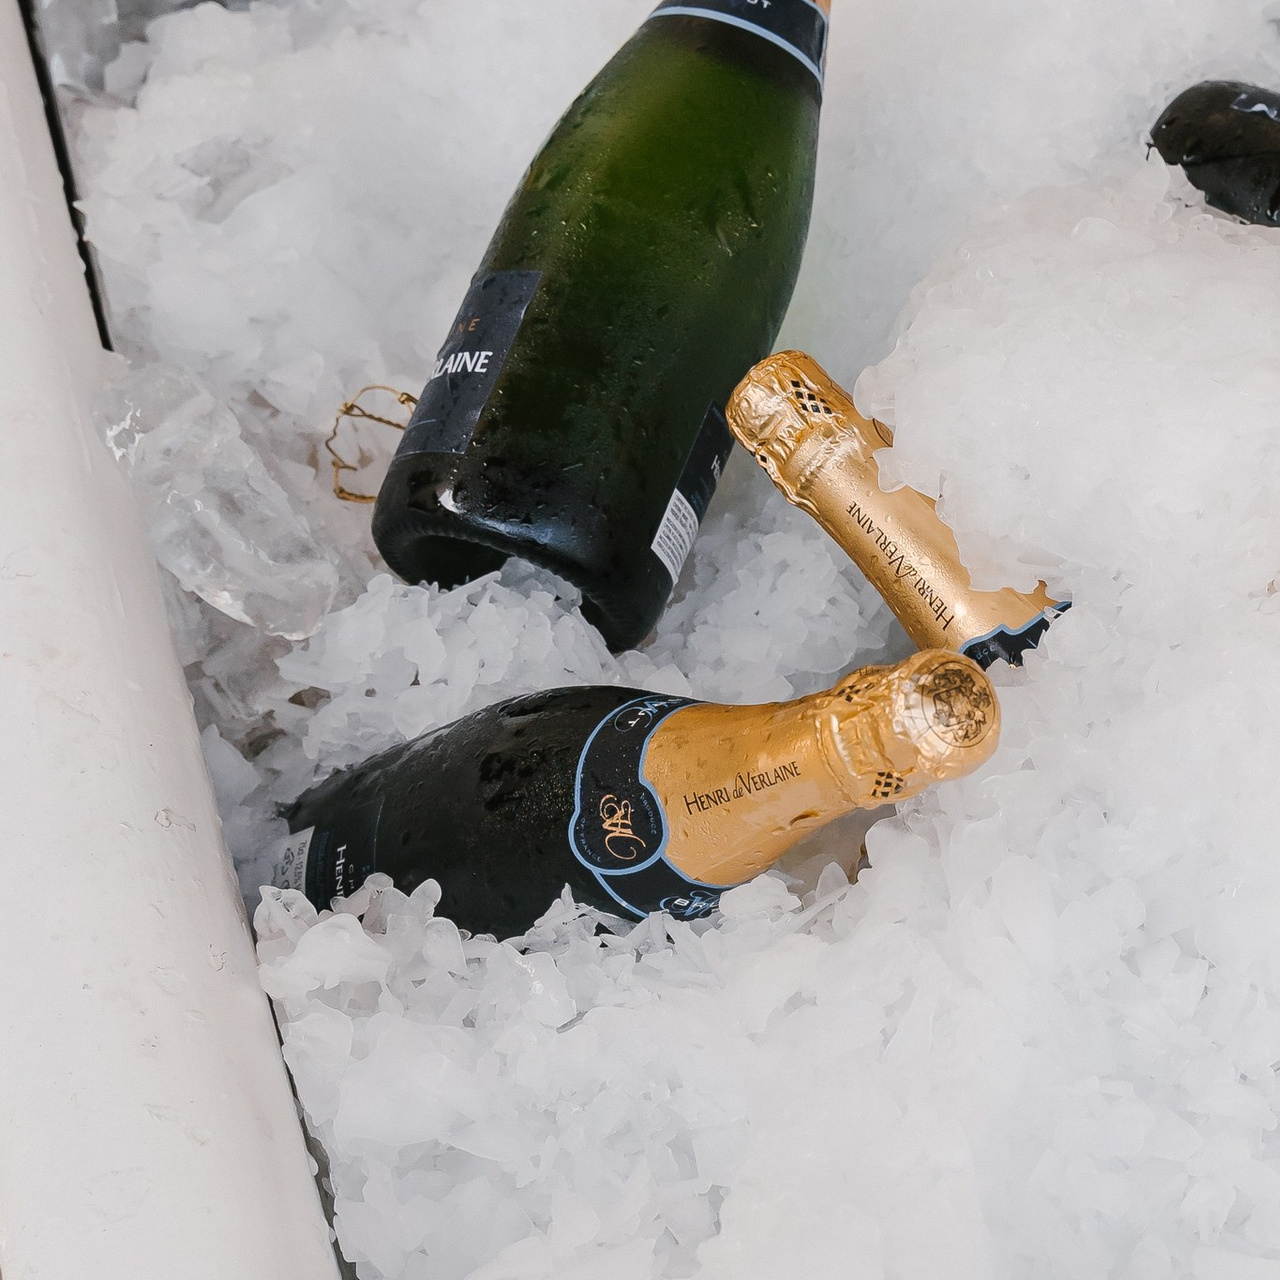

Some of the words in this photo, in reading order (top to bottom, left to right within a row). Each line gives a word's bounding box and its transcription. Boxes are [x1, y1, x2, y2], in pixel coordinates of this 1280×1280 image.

[431, 350, 494, 381] LAINE
[846, 500, 905, 577] VERLAINE
[914, 577, 955, 631] HENRI
[683, 787, 730, 816] HENRI
[738, 760, 801, 795] VERLAINE
[336, 844, 348, 897] HEN
